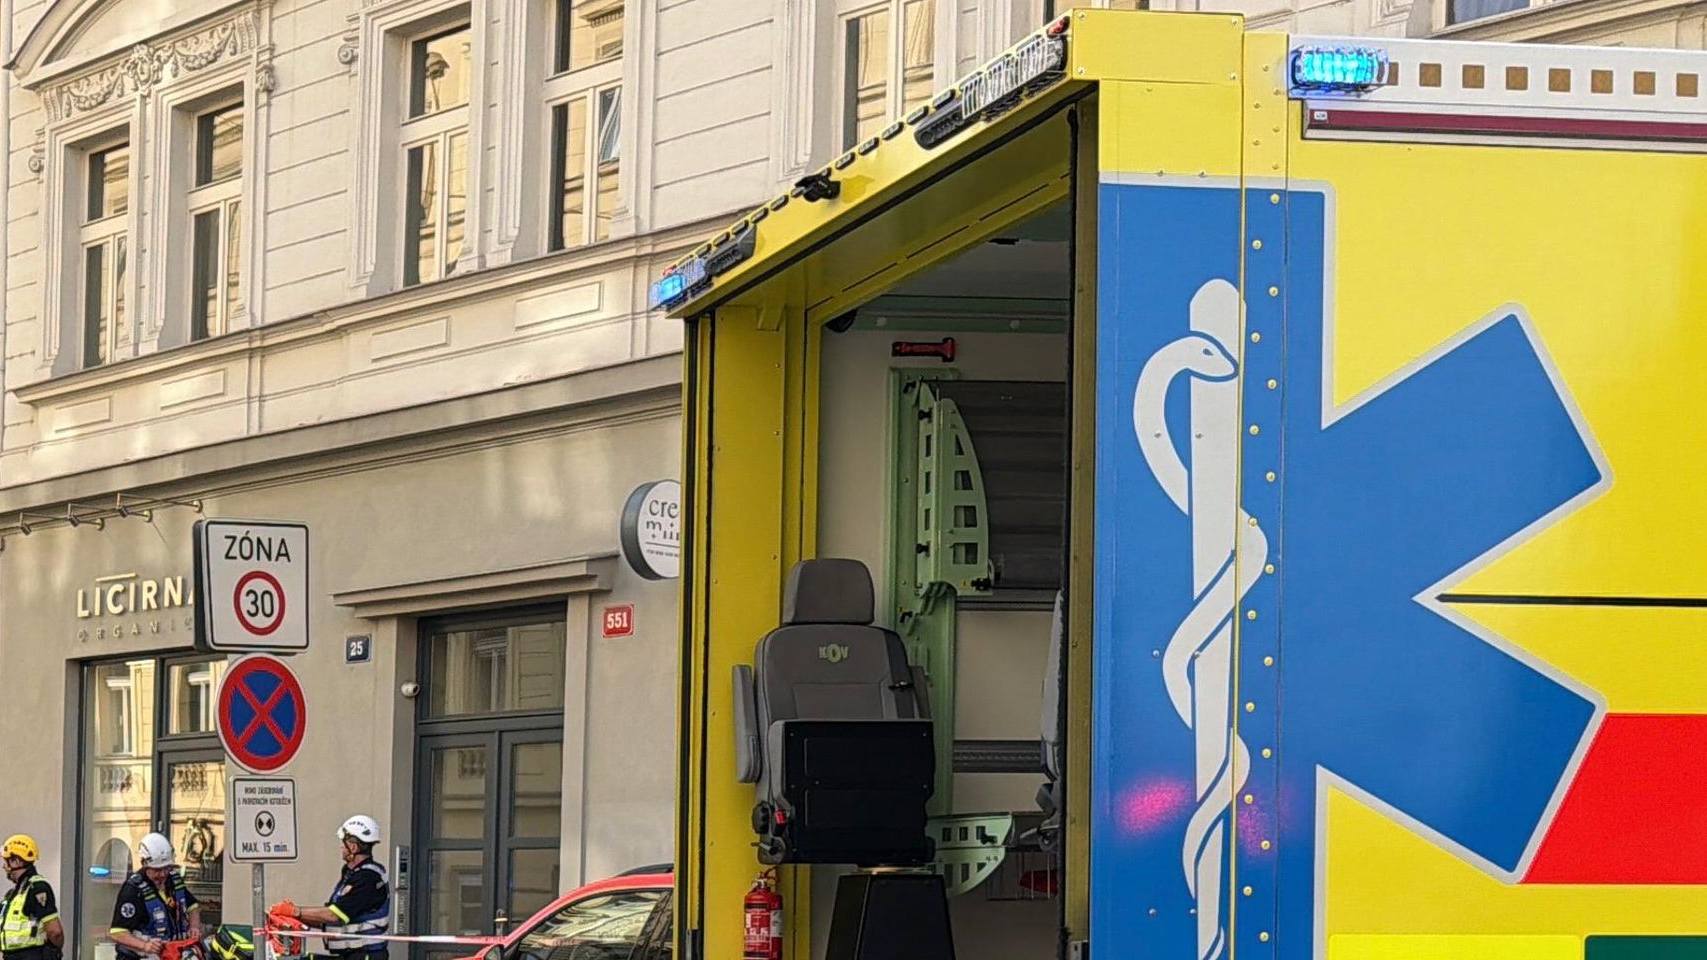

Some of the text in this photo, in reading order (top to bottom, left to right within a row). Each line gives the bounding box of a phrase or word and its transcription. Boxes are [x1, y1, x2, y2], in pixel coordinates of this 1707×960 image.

[224, 530, 291, 563] ZÓNA
[245, 589, 275, 618] 30
[606, 612, 628, 629] 551
[350, 641, 363, 656] 25
[263, 841, 271, 852] 15
